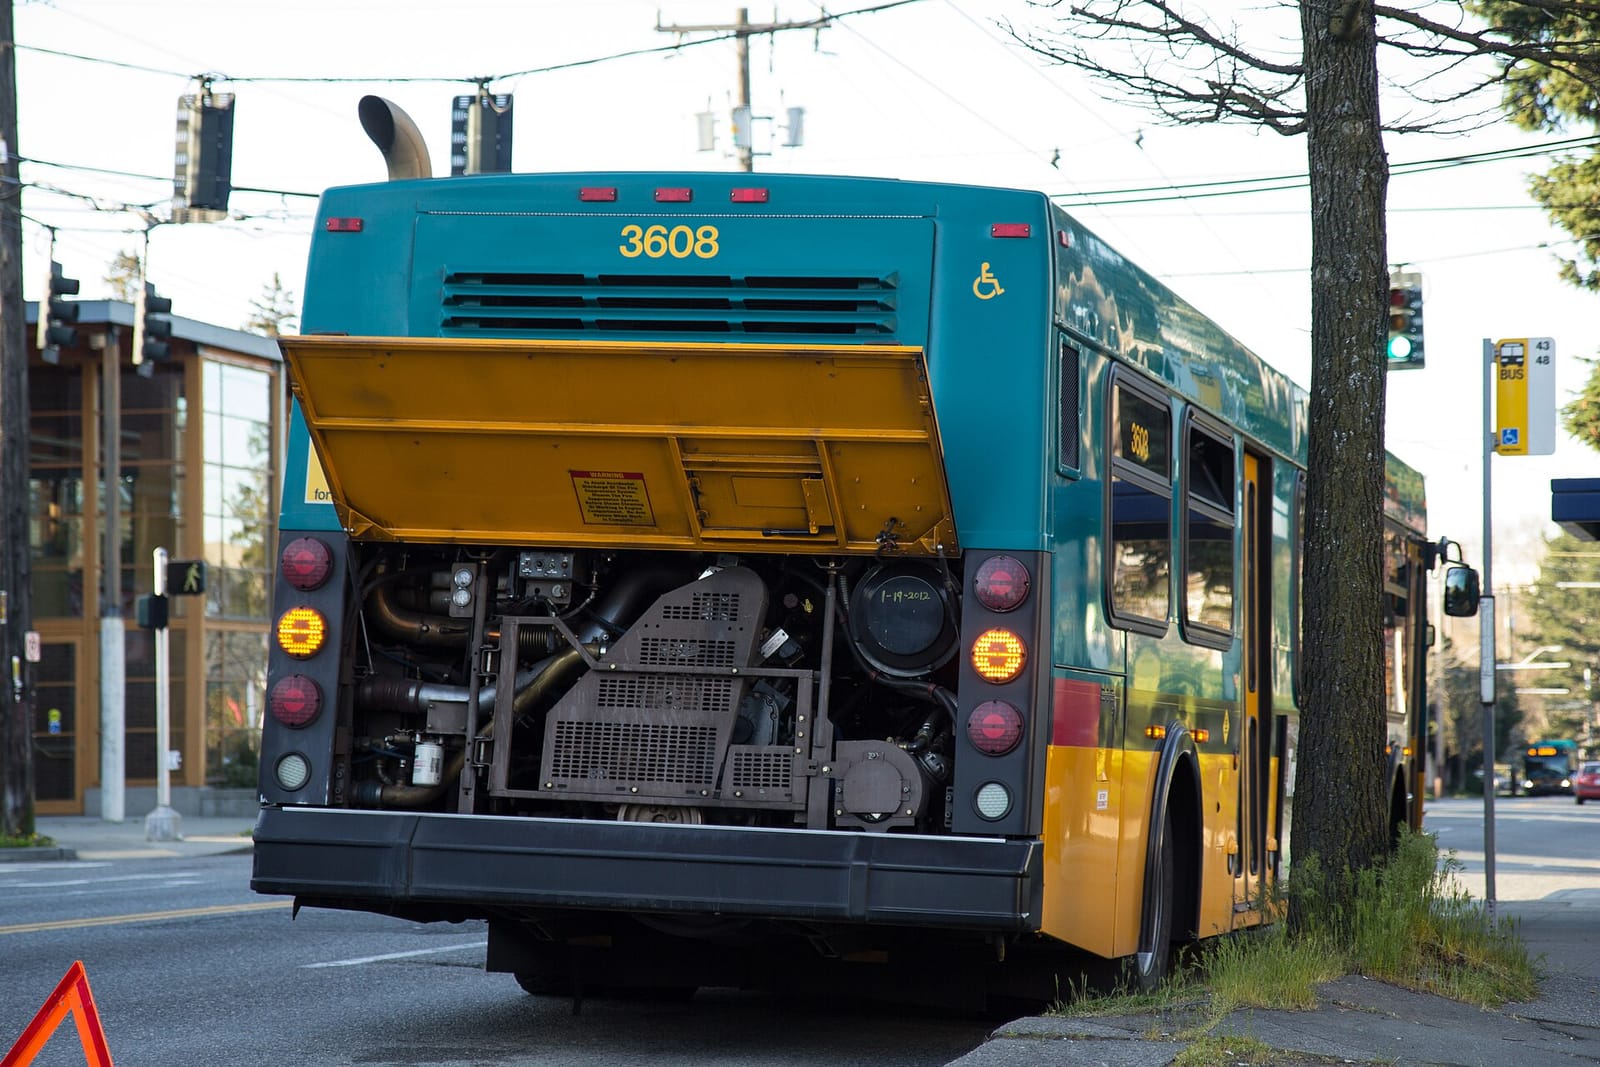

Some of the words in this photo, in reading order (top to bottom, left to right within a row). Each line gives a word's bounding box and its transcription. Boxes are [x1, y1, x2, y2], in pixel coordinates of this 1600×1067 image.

[620, 224, 720, 259] 3608
[1536, 340, 1550, 351] 43
[1536, 355, 1550, 366] 48
[1500, 368, 1524, 381] BUS
[1131, 422, 1149, 462] 3608
[881, 590, 931, 604] 1-19-2012
